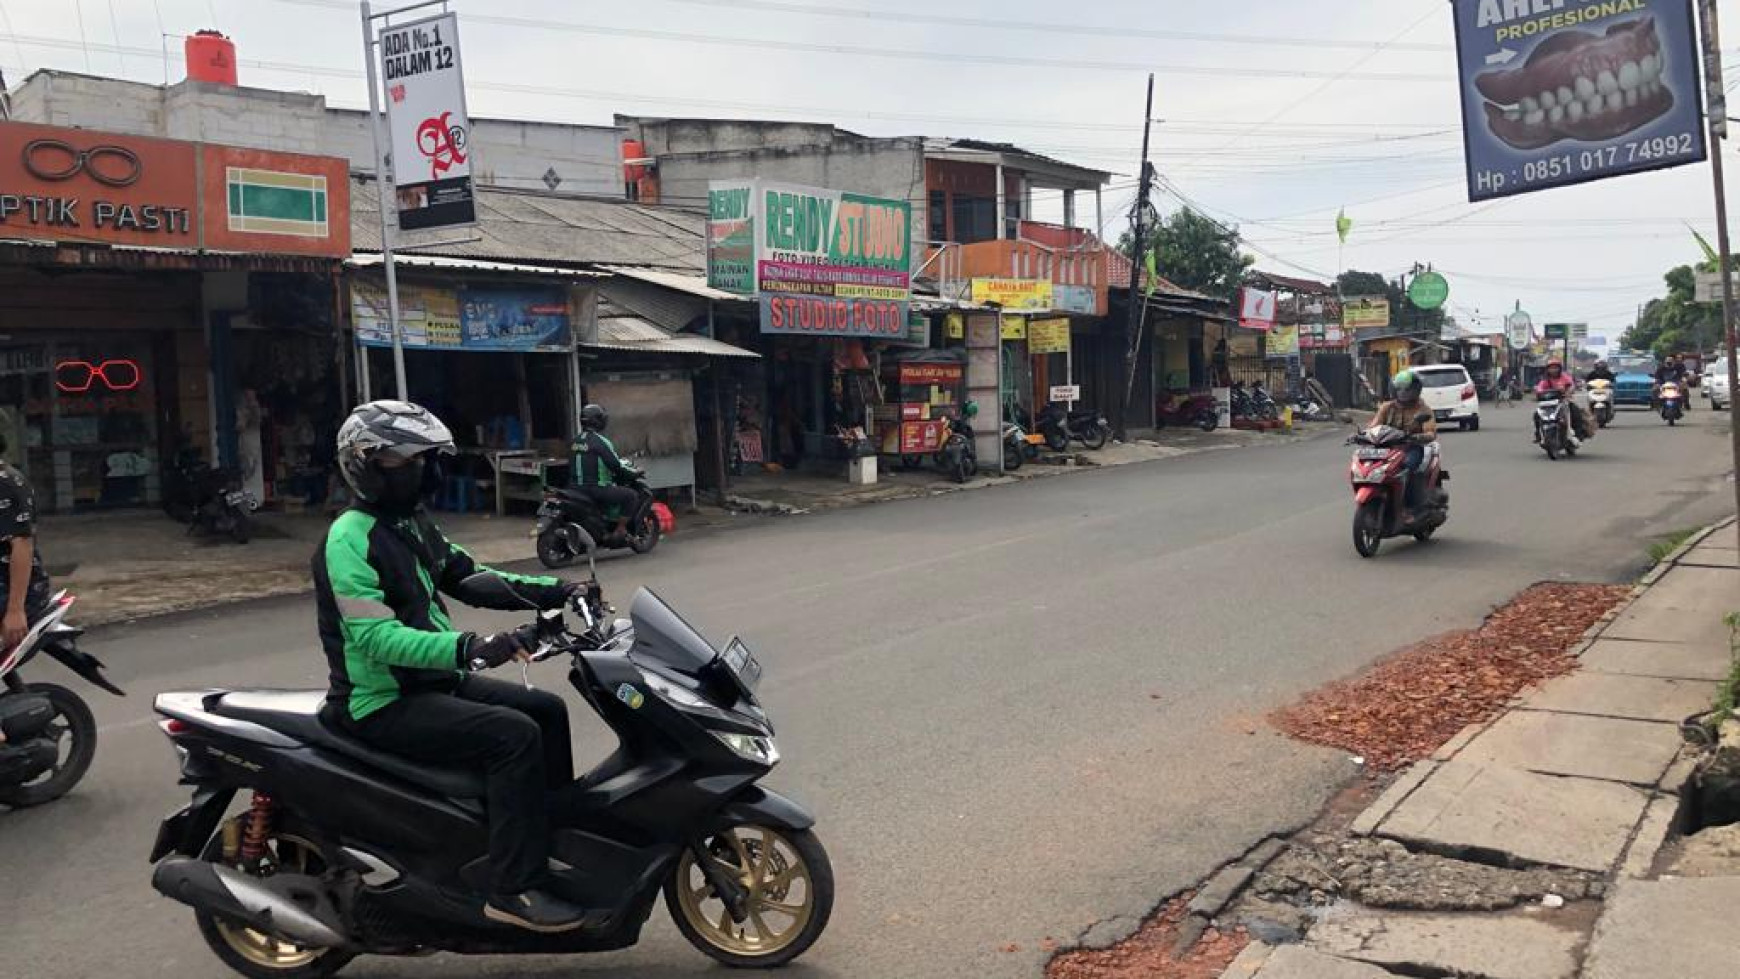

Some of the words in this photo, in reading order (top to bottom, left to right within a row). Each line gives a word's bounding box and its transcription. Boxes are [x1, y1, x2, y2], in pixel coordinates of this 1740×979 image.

[1496, 0, 1647, 42] PROFESIONAL
[385, 31, 410, 57] ADA
[385, 50, 432, 81] DALAM
[434, 46, 454, 70] 12
[1477, 170, 1504, 191] Hp
[1523, 155, 1571, 182] 0851
[1579, 147, 1617, 171] 017
[1625, 133, 1692, 163] 74992
[0, 194, 80, 227] PTIK
[95, 203, 190, 233] PASTI
[708, 187, 750, 220] RENDY
[766, 190, 832, 254] RENDY
[838, 200, 905, 260] STUDIO
[770, 297, 848, 331] STUDIO
[852, 301, 900, 334] FOTO
